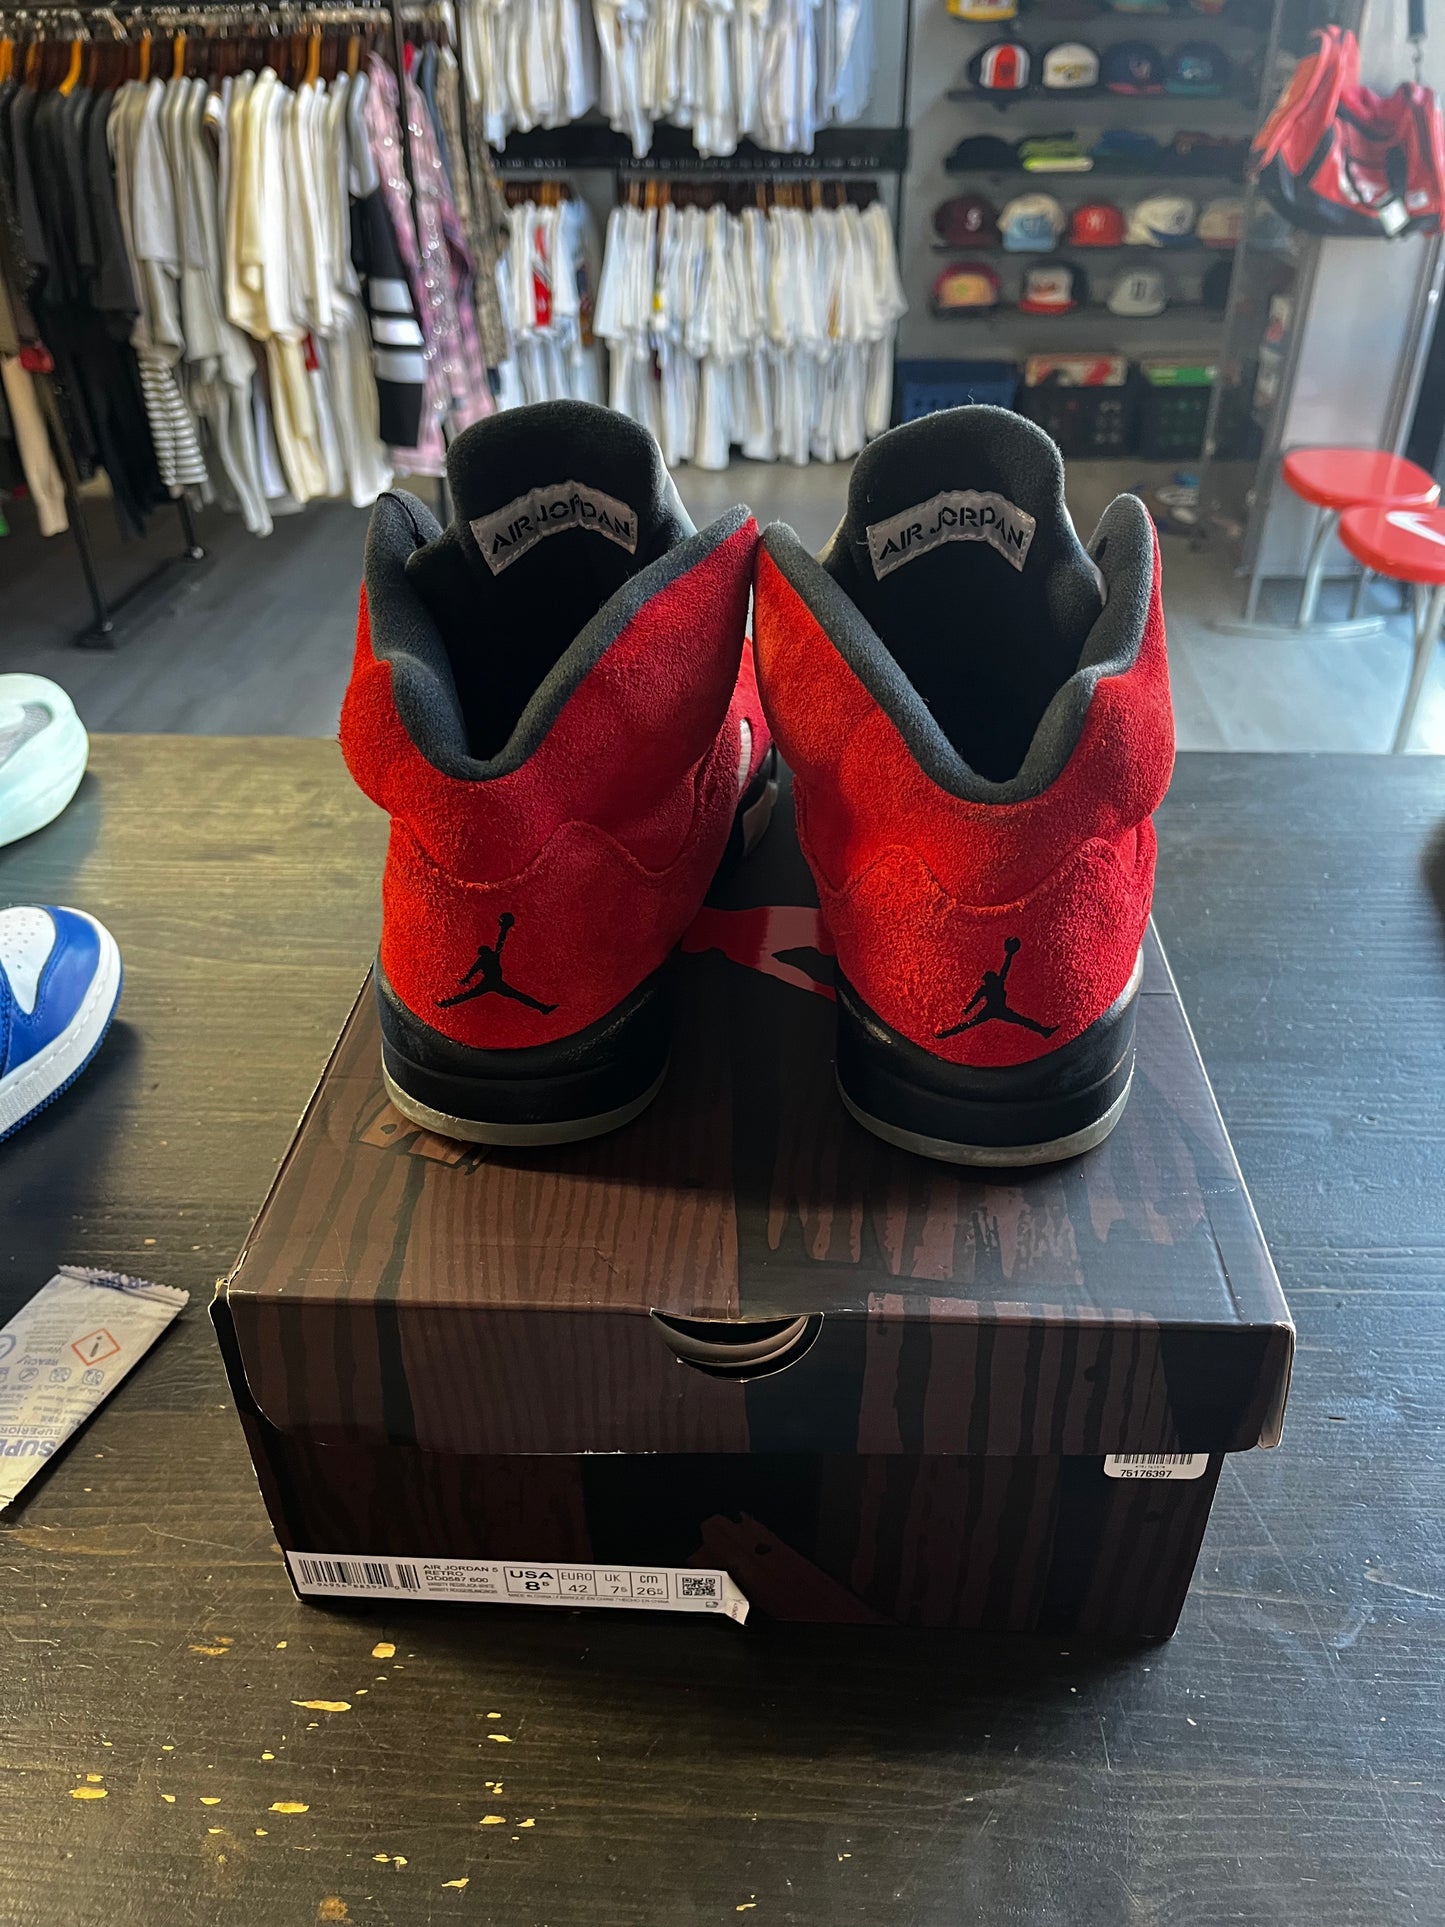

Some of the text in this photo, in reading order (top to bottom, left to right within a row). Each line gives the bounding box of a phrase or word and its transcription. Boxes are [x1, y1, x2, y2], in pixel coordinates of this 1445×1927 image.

[492, 515, 534, 555] AIR
[879, 506, 1024, 560] AIR JORDAN
[1120, 1470, 1172, 1478] 75176397
[510, 1570, 554, 1580] USA
[561, 1572, 592, 1581] EURO
[604, 1574, 621, 1582] UK
[568, 1584, 588, 1593] 42
